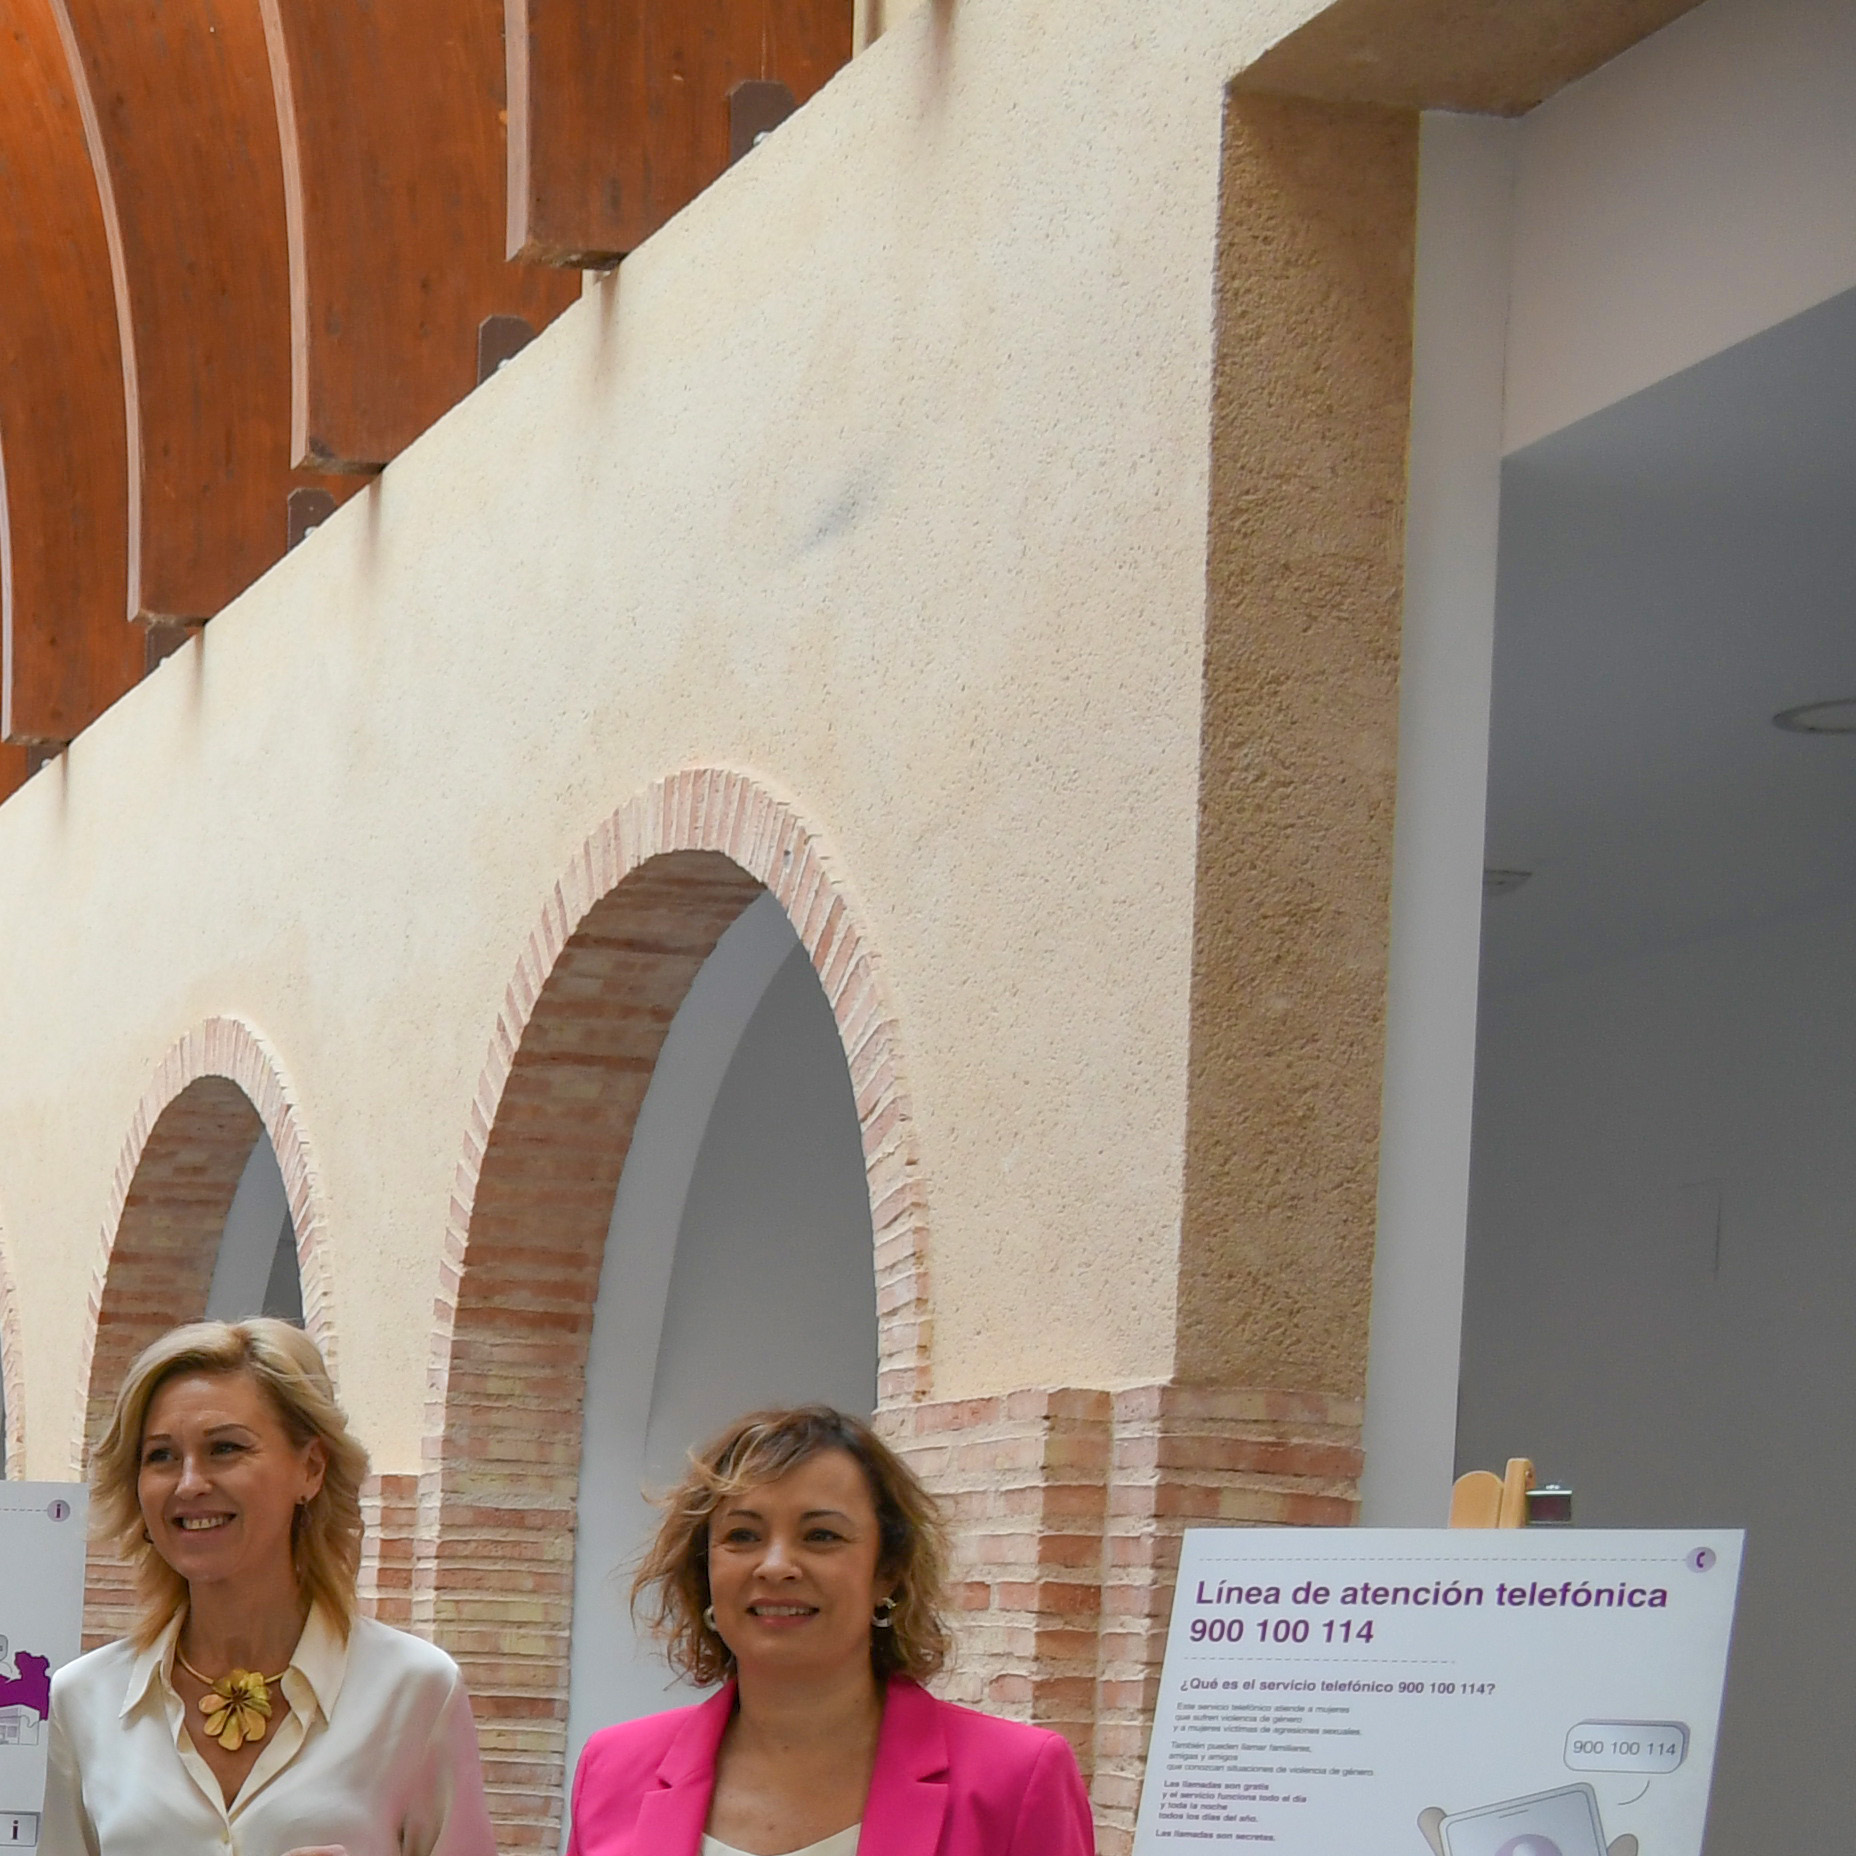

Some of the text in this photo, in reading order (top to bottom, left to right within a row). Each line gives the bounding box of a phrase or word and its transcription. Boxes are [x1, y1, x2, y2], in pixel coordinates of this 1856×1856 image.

[1196, 1579, 1668, 1608] Línea de atención telefónica
[1189, 1618, 1374, 1644] 900 100 114
[1180, 1677, 1496, 1695] ¿Qué es el servicio telefónico 900 100 114?
[1572, 1740, 1676, 1756] 900 100 114
